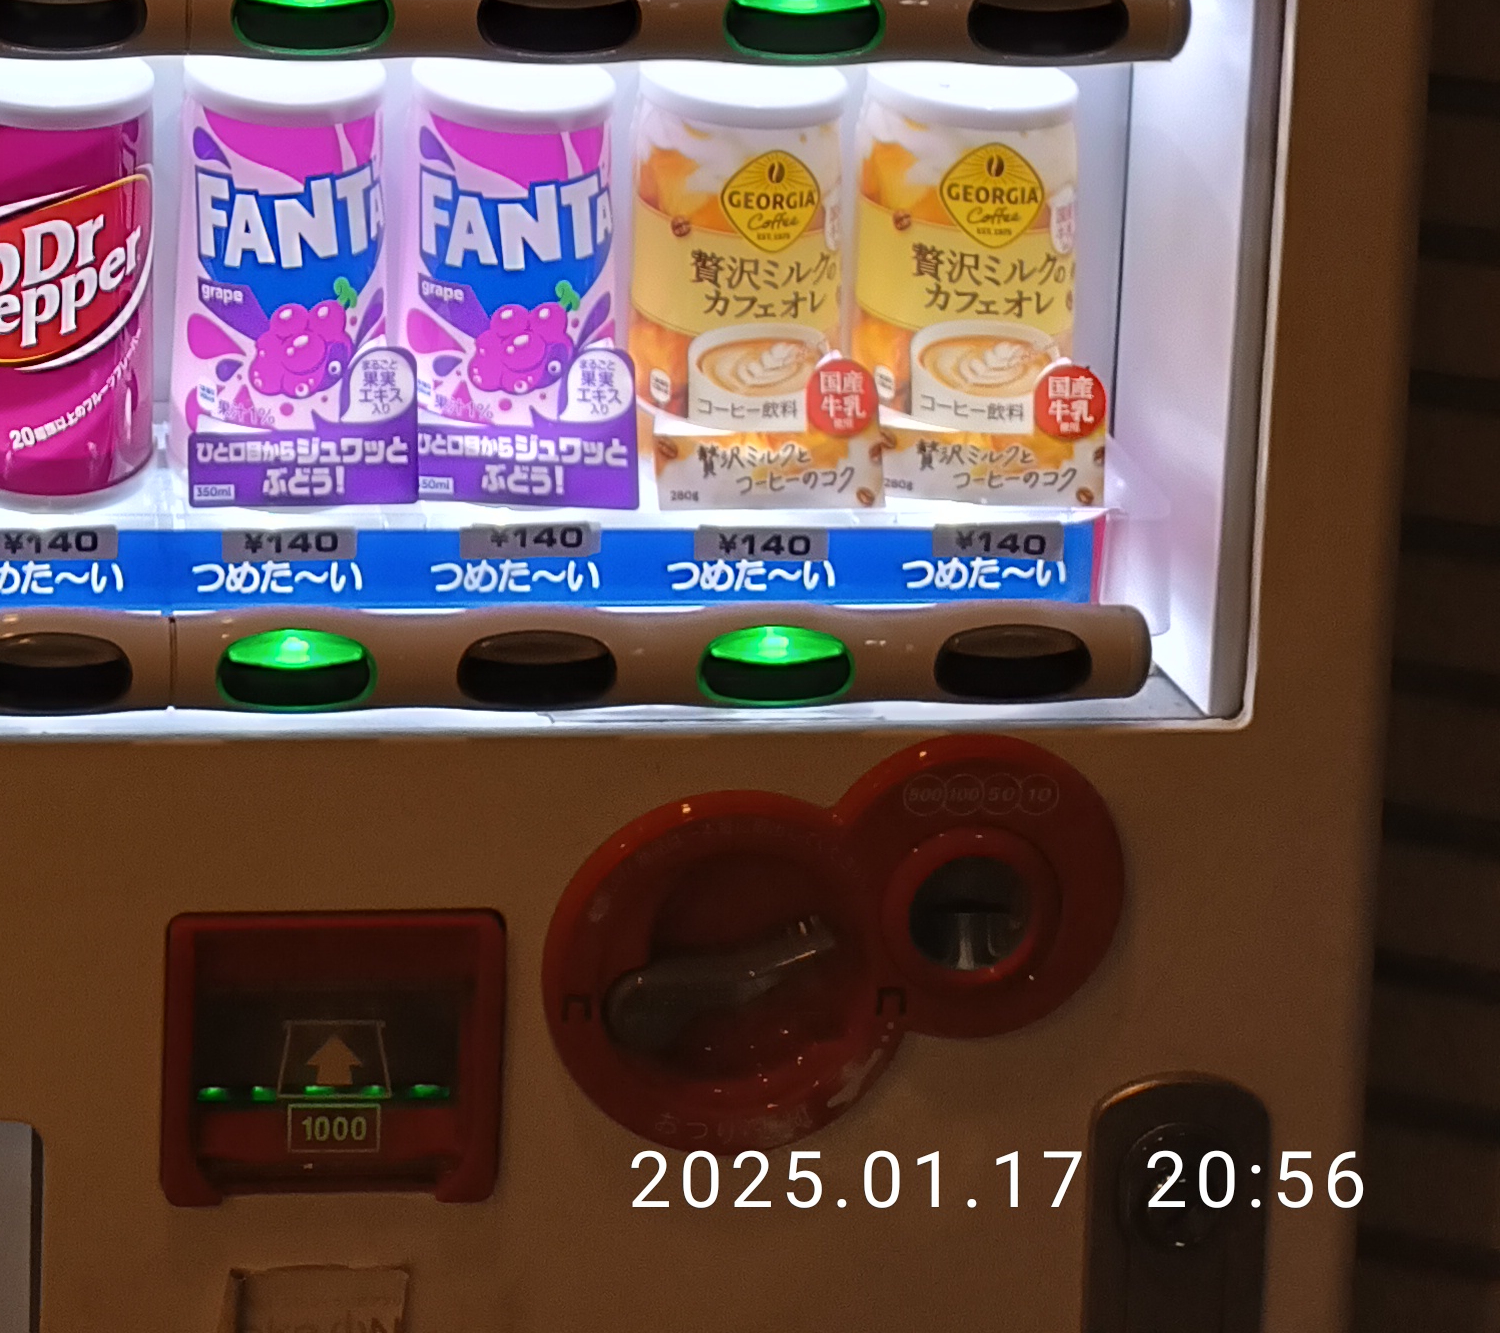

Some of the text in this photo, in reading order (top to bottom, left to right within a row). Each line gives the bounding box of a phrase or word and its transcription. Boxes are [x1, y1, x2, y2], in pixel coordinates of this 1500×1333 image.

[420, 174, 613, 271] FANTA
[912, 243, 1066, 285] 贅沢ミルクの
[201, 283, 244, 305] grape
[925, 284, 1054, 316] カフェオレ
[819, 371, 864, 394] 国産
[357, 387, 403, 405] エキス
[819, 395, 866, 417] 牛乳
[196, 436, 409, 464] ひと口目からジュワッと
[4, 530, 98, 555] ¥140
[245, 530, 339, 555] ¥140
[719, 533, 811, 558] ¥140
[301, 1116, 367, 1142] 1000
